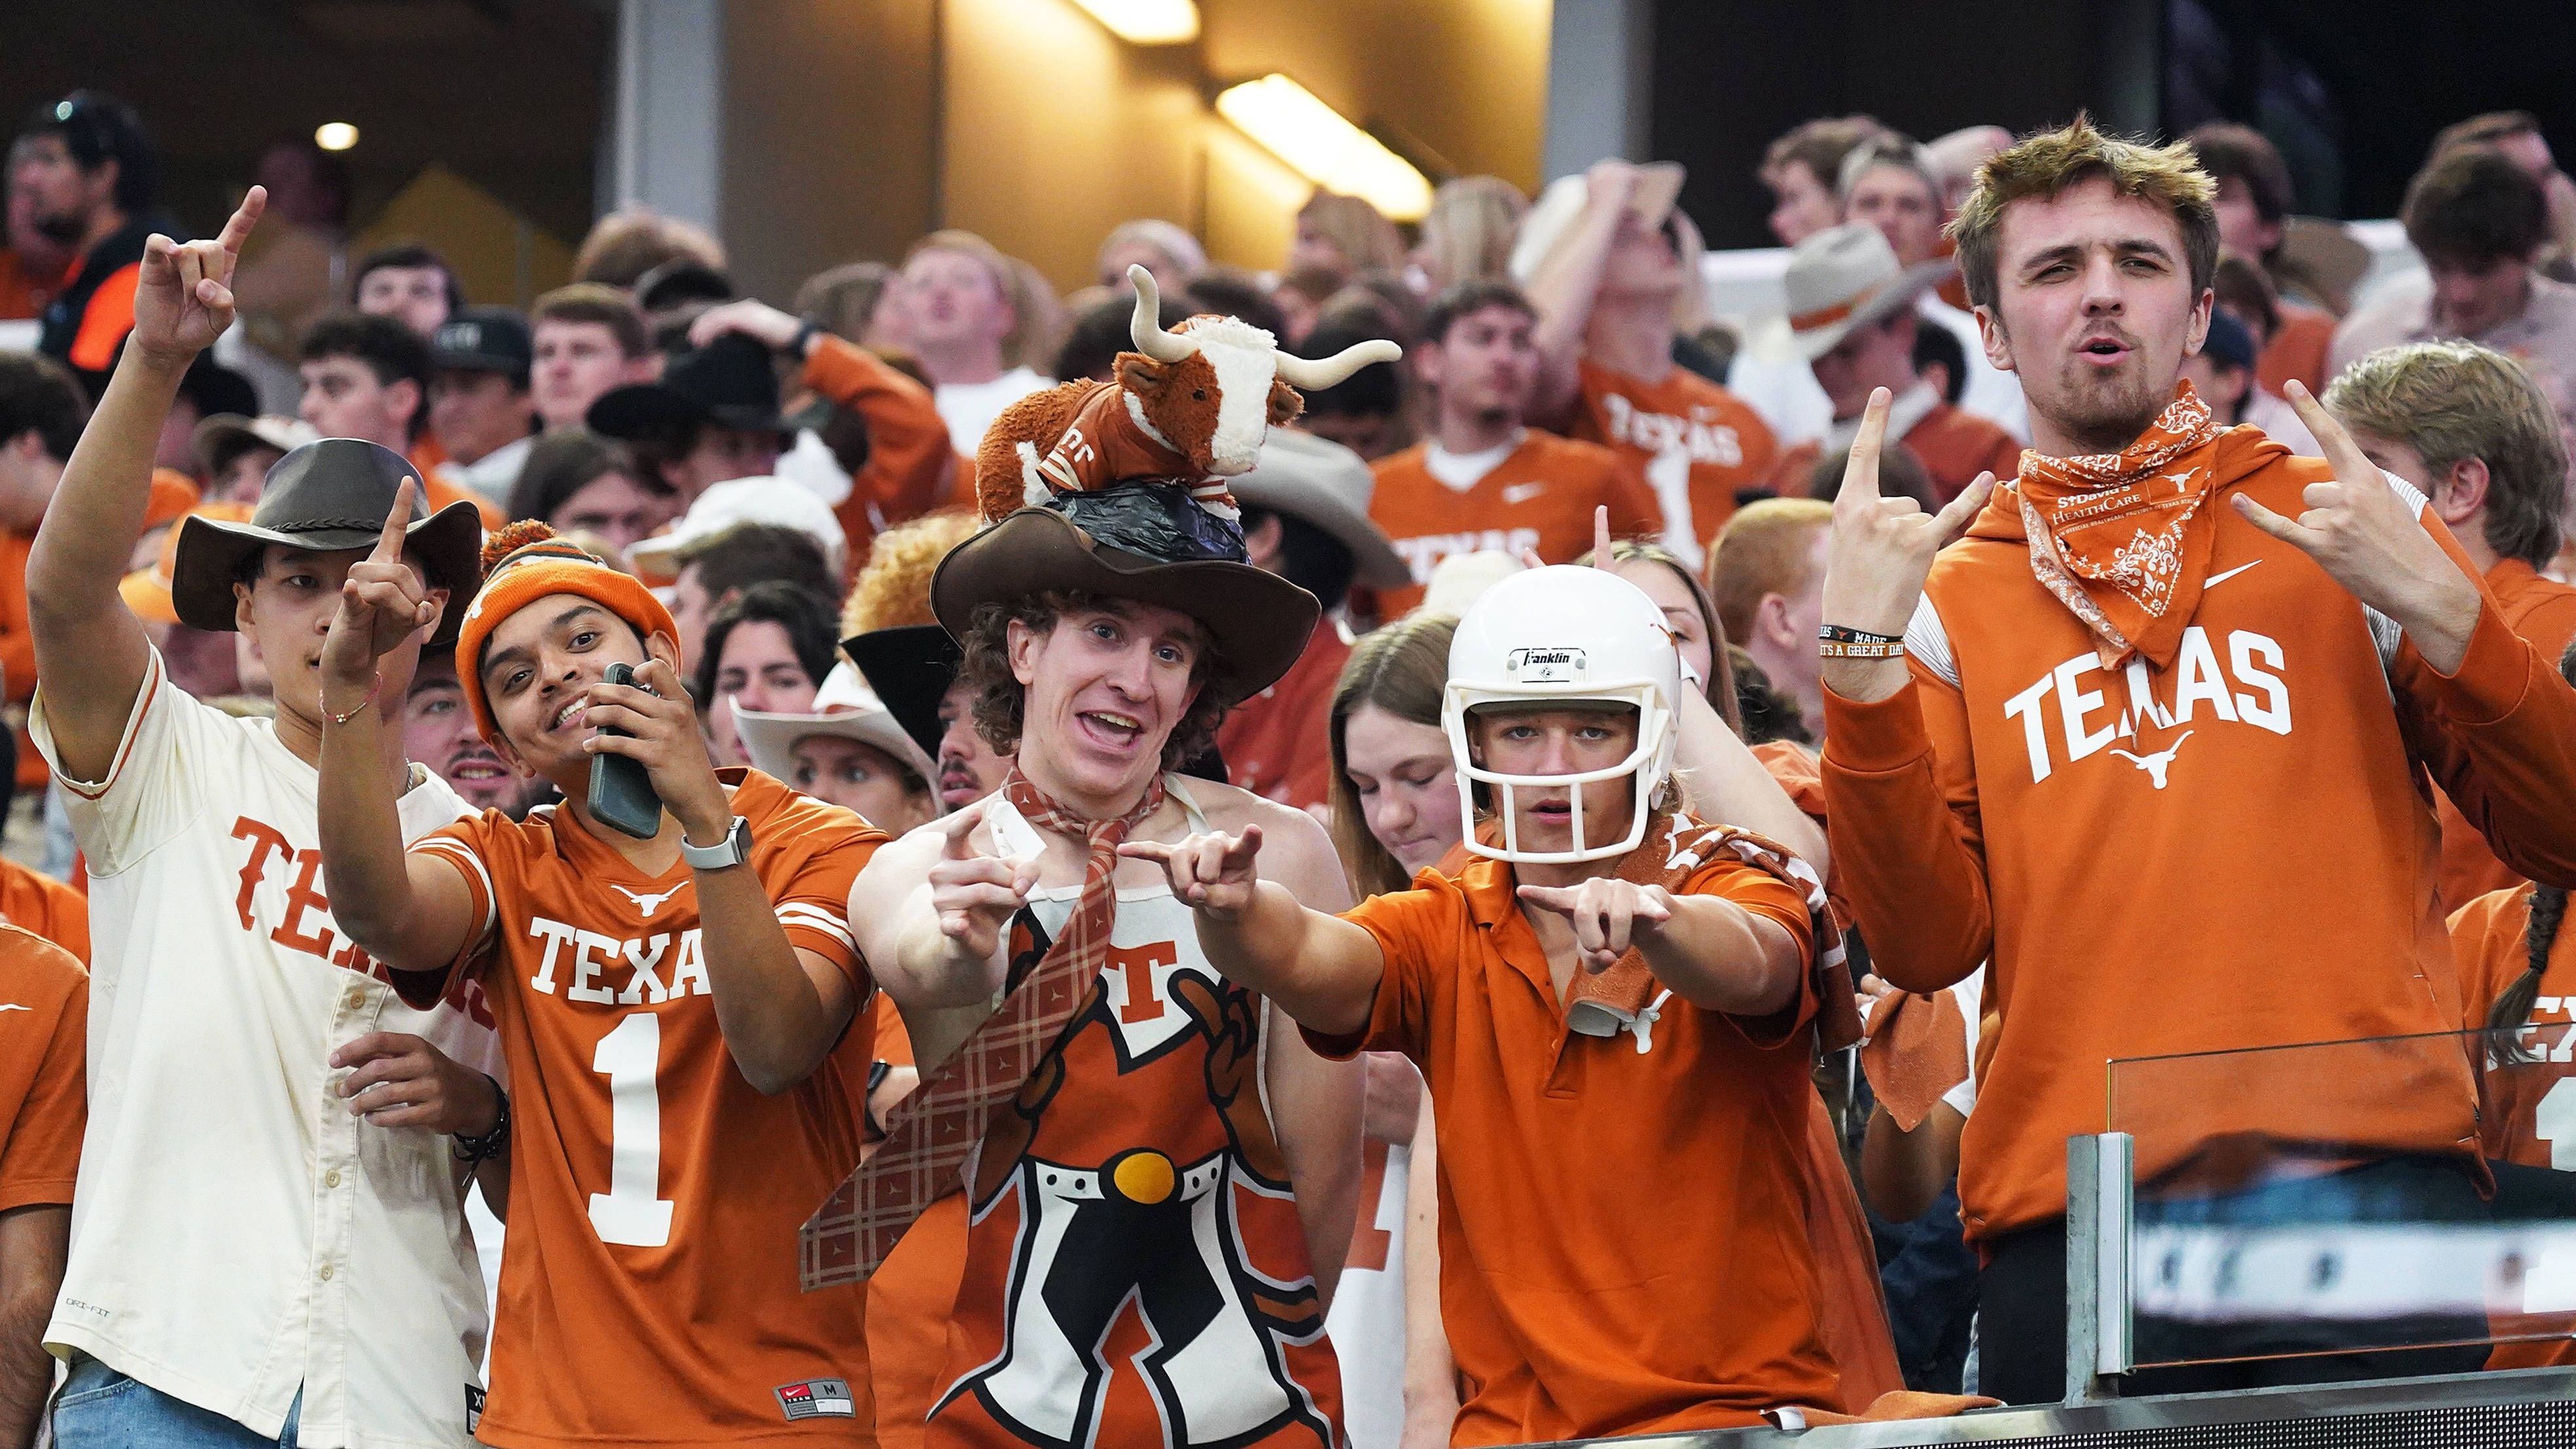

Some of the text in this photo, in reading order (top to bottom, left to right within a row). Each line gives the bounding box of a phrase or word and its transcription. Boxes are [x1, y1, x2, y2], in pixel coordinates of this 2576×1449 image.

[1603, 393, 1744, 469] TEXAS
[1835, 645, 1844, 656] A
[1847, 645, 1886, 656] GREAT
[1105, 940, 1177, 1024] T
[588, 1012, 674, 1247] 1
[65, 1298, 110, 1317] DRI-FIT
[823, 1384, 838, 1395] M
